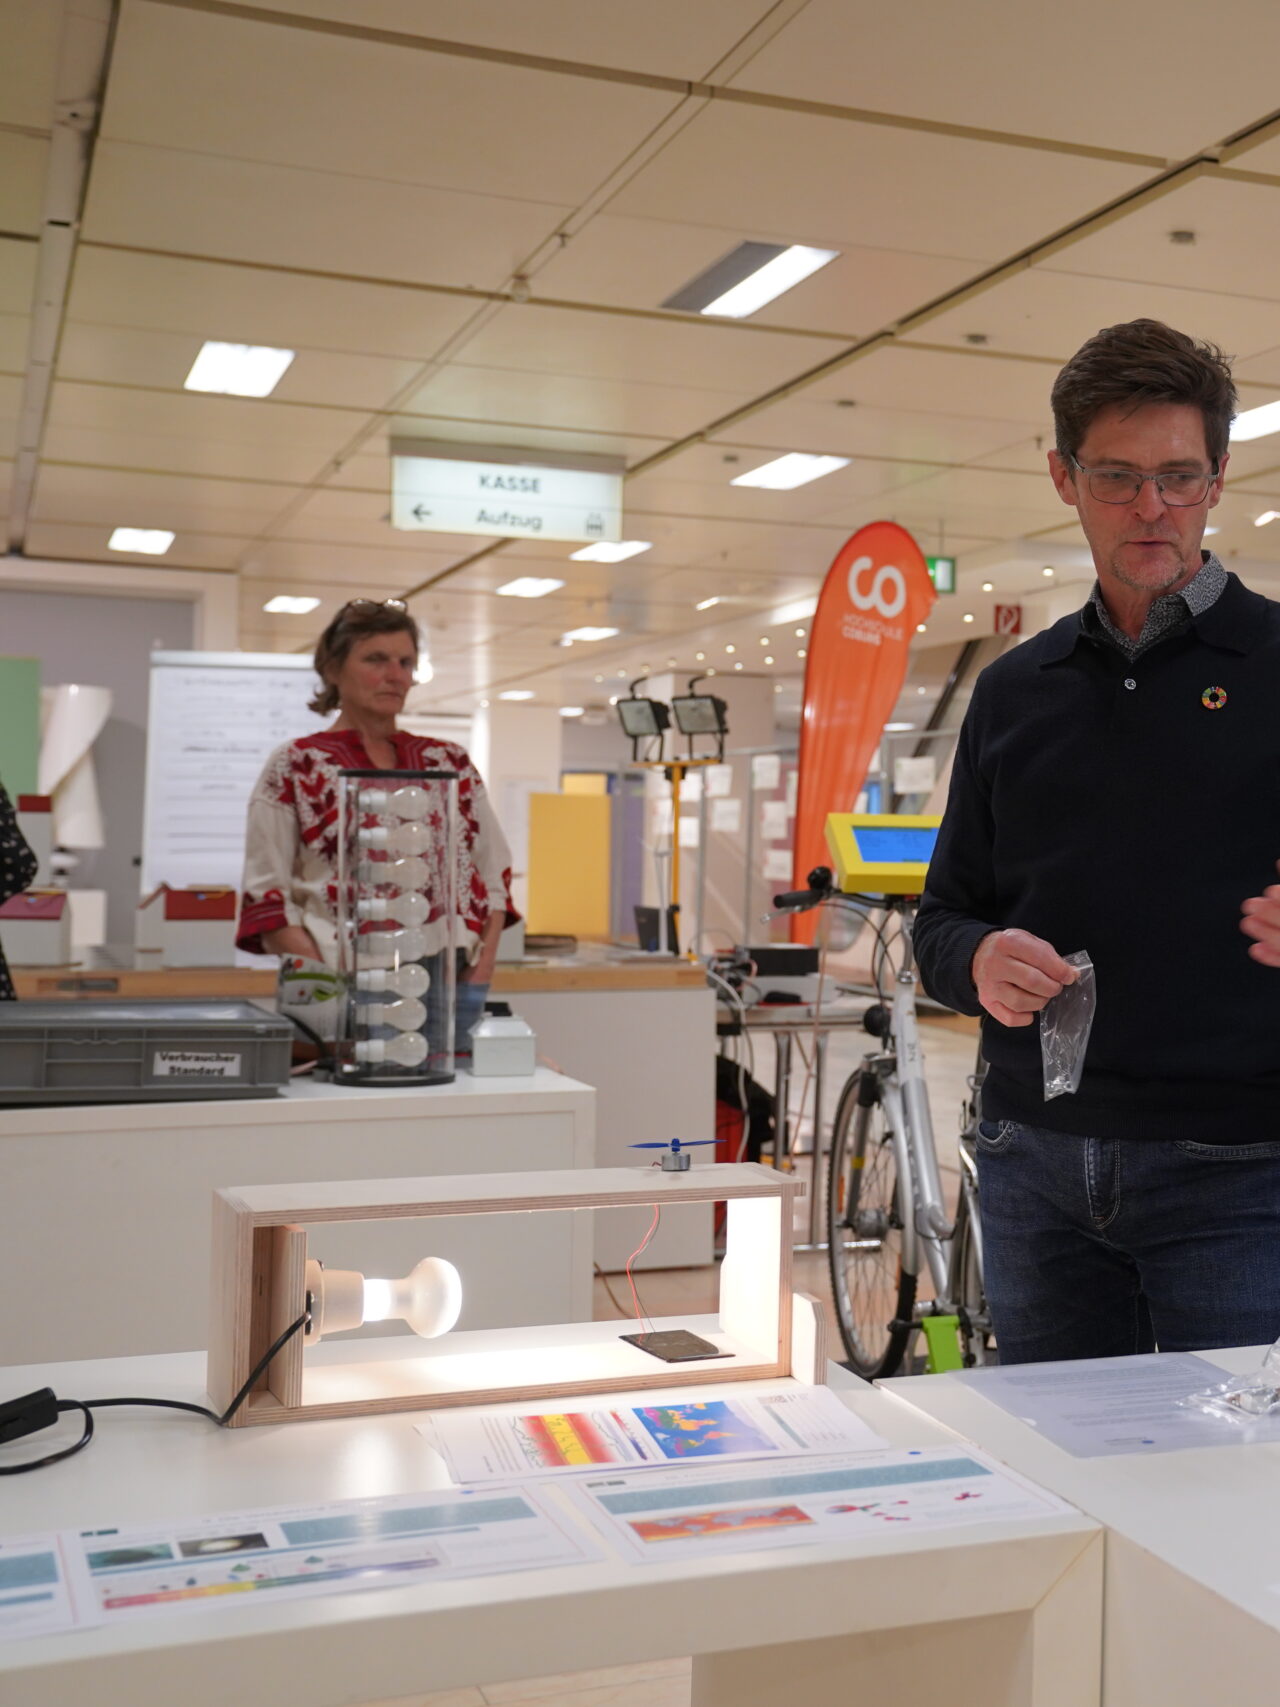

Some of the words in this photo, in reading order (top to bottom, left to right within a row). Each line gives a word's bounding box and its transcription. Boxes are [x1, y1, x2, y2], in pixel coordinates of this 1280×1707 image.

[479, 474, 541, 494] KASSE
[476, 507, 543, 532] Aufzug
[160, 1052, 235, 1063] Verbraucher
[169, 1065, 225, 1077] Standard
